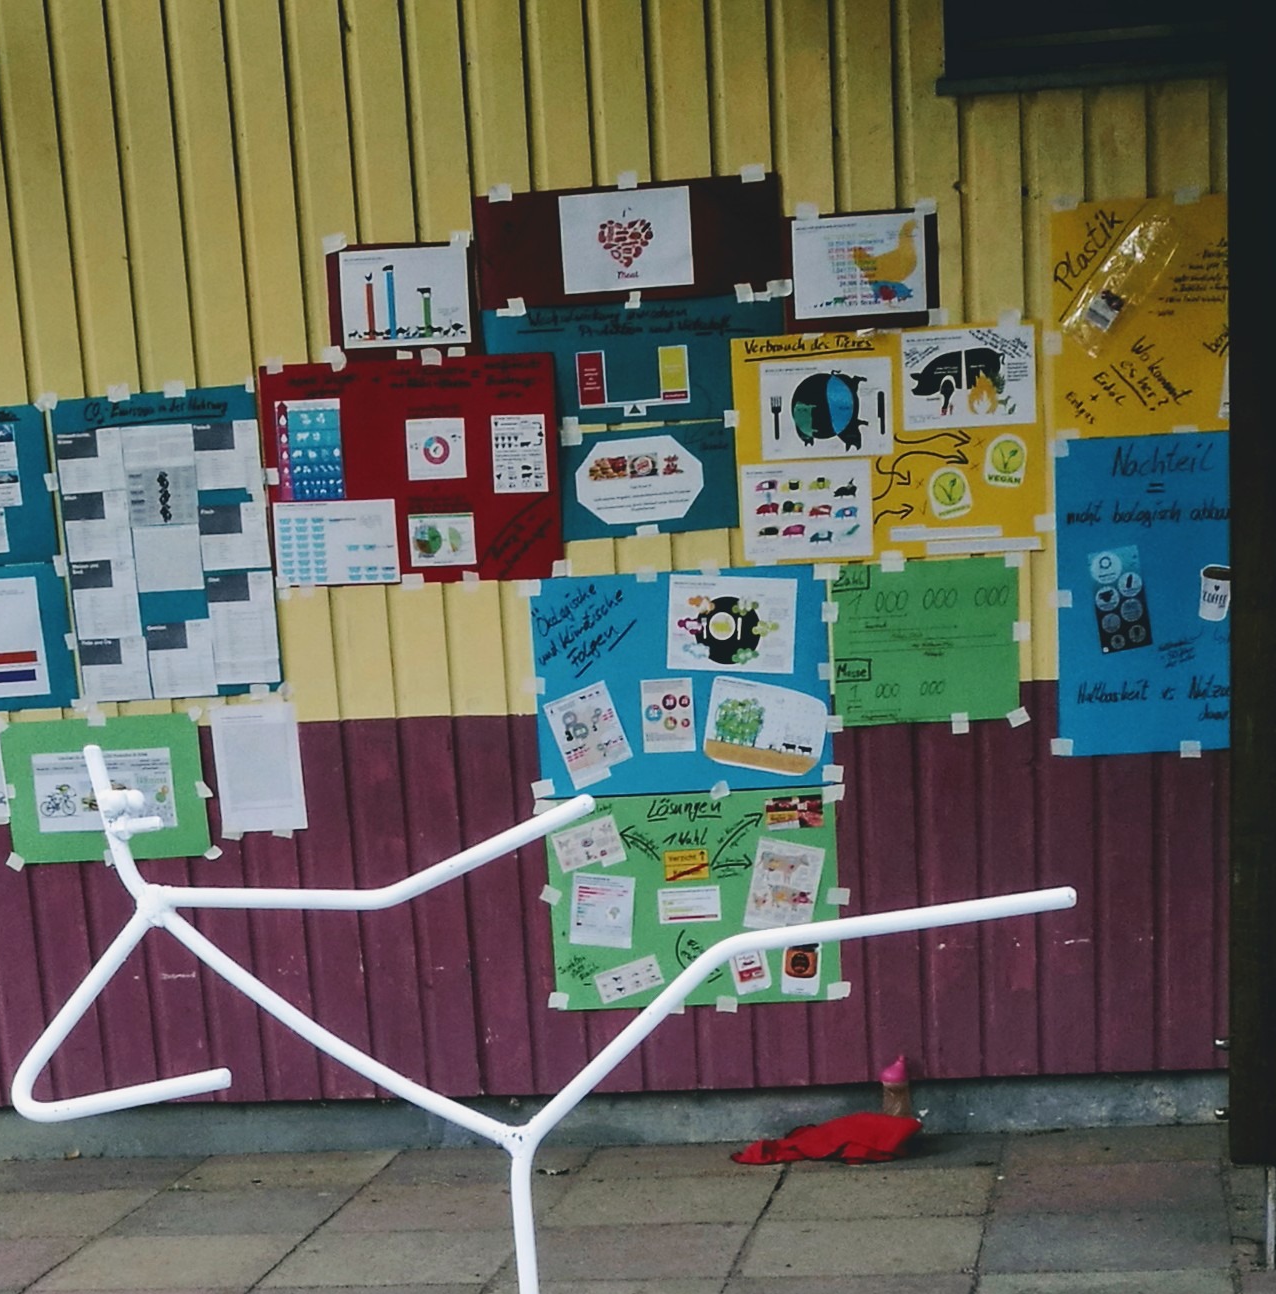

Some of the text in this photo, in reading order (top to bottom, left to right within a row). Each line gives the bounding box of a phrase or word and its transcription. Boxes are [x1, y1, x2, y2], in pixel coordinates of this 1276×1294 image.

[1054, 209, 1124, 291] Plastik
[744, 338, 806, 354] Verbrauch
[1131, 335, 1154, 363] Wo
[1111, 443, 1214, 477] Nachteil
[986, 473, 1021, 484] VEGAN
[647, 799, 721, 822] Lösungen
